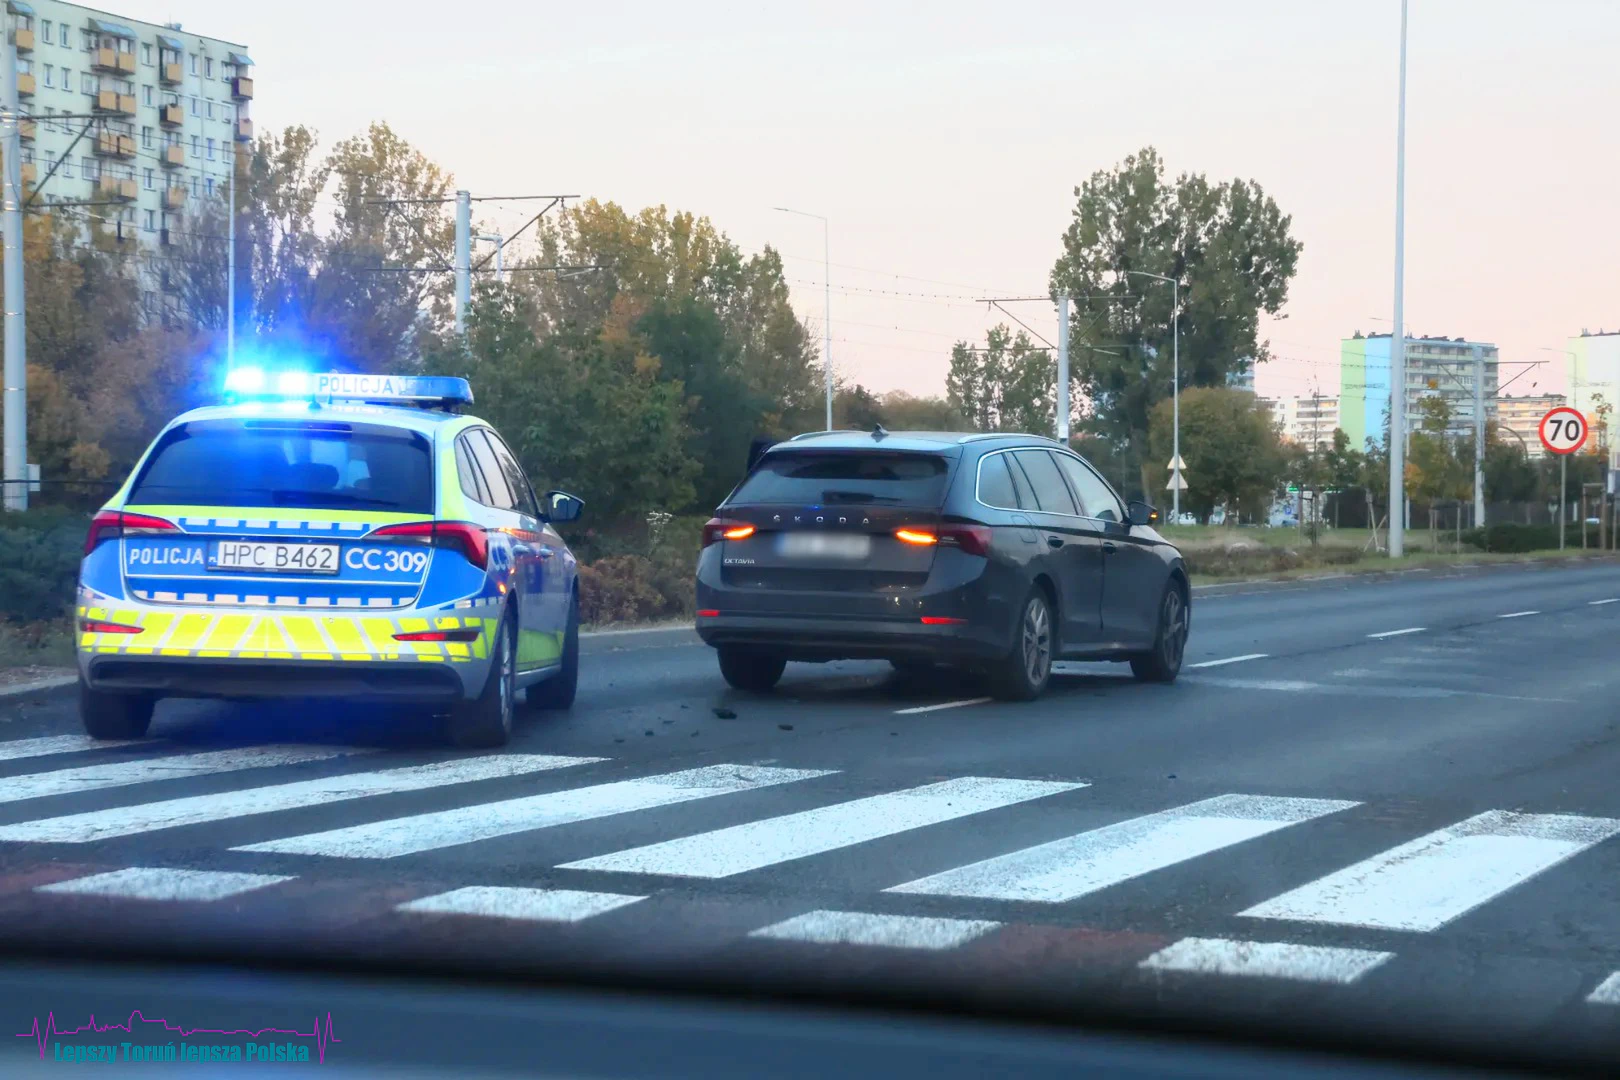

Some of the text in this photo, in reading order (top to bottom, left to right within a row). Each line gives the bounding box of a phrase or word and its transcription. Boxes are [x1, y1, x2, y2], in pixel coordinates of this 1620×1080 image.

[320, 376, 393, 394] POLICJA
[1549, 419, 1580, 441] 70
[129, 547, 204, 565] POLICJA
[222, 543, 333, 569] HPC B462
